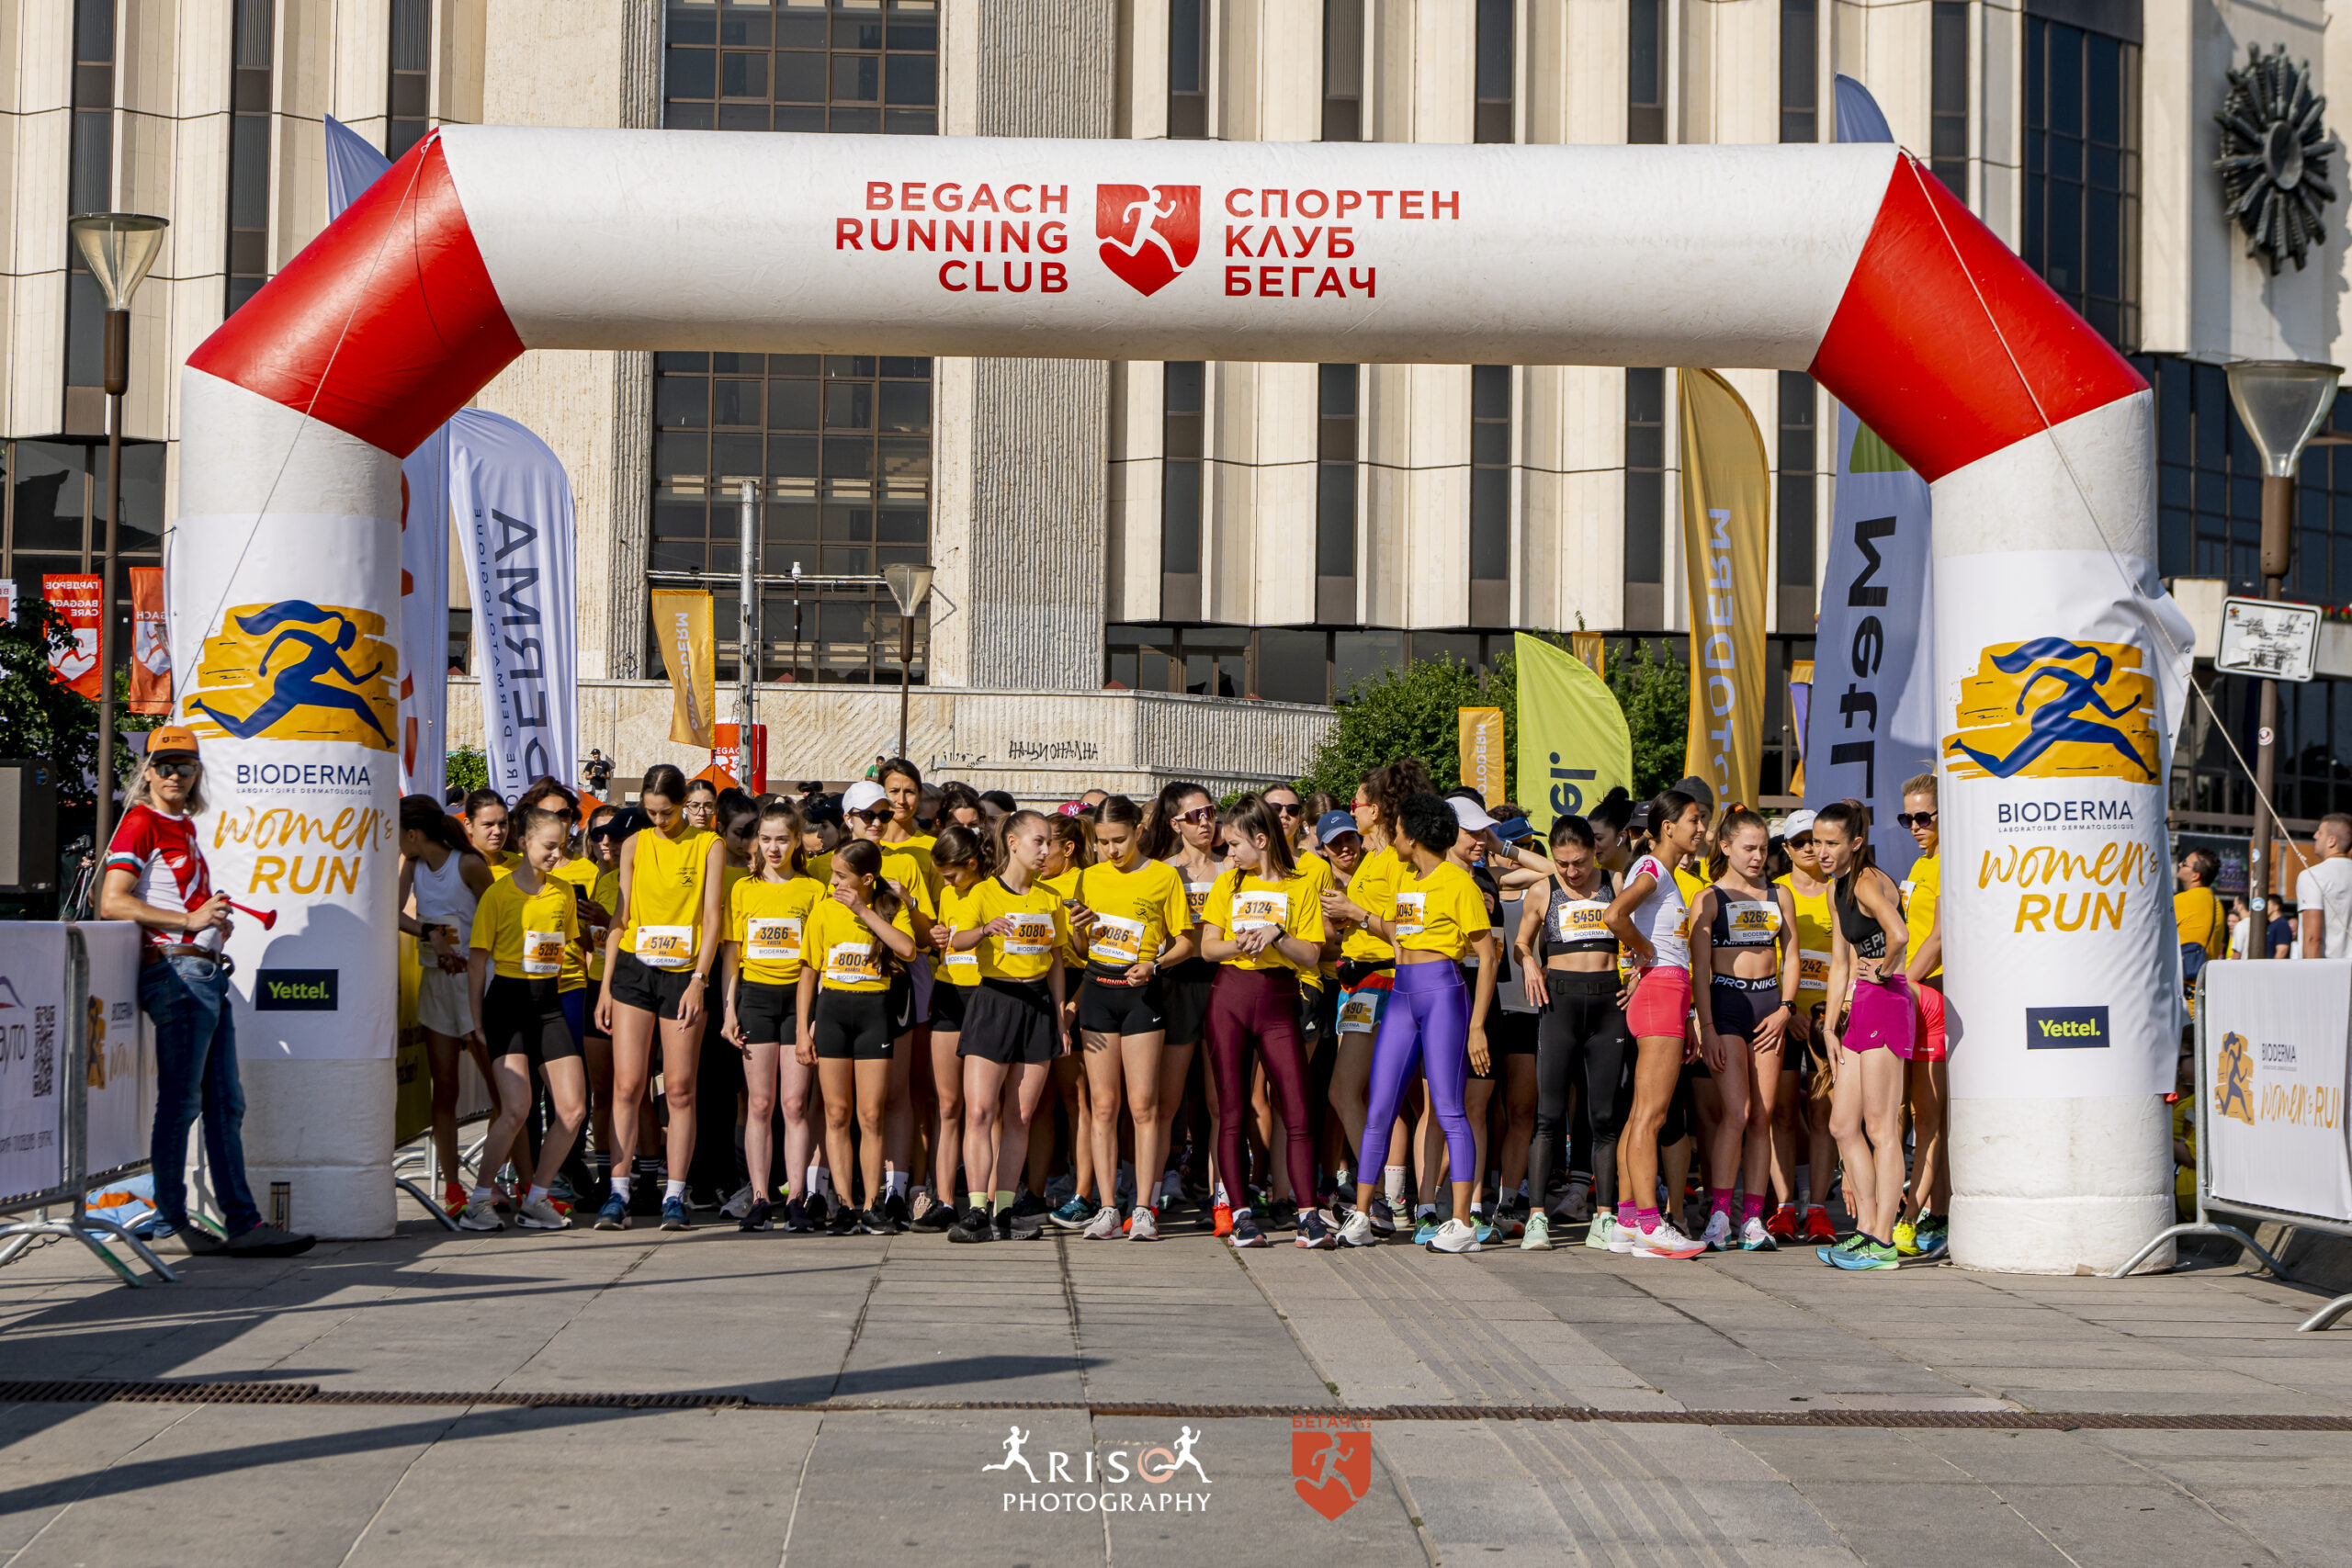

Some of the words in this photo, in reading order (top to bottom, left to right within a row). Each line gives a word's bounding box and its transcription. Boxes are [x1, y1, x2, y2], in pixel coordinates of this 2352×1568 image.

[866, 181, 1069, 213] BEGACH
[1225, 188, 1460, 220] СПОРТЕН
[835, 218, 1069, 254] RUNNING
[1225, 225, 1355, 259] КЛУБ
[938, 260, 1069, 294] CLUB
[1225, 265, 1377, 299] БЕГАЧ
[237, 764, 370, 785] BIODERMA
[1998, 800, 2133, 823] BIODERMA
[2062, 823, 2134, 831] DERMATOLOGIQUE
[248, 855, 362, 895] RUN
[1245, 901, 1272, 914] 3124
[1573, 909, 1601, 923] 5450
[2014, 891, 2126, 933] RUN
[1743, 911, 1769, 923] 3262
[760, 927, 788, 940] 3266
[1018, 925, 1046, 937] 3080
[1100, 925, 1130, 942] 3086
[650, 937, 677, 949] 5147
[1097, 946, 1125, 956] BIODERMA
[1801, 961, 1822, 973] 242
[268, 981, 330, 998] Yettel.
[1715, 976, 1747, 989] PRO
[1752, 976, 1777, 990] NIKE
[2038, 1018, 2101, 1037] Yettel.
[2262, 1043, 2296, 1063] BIODERMA
